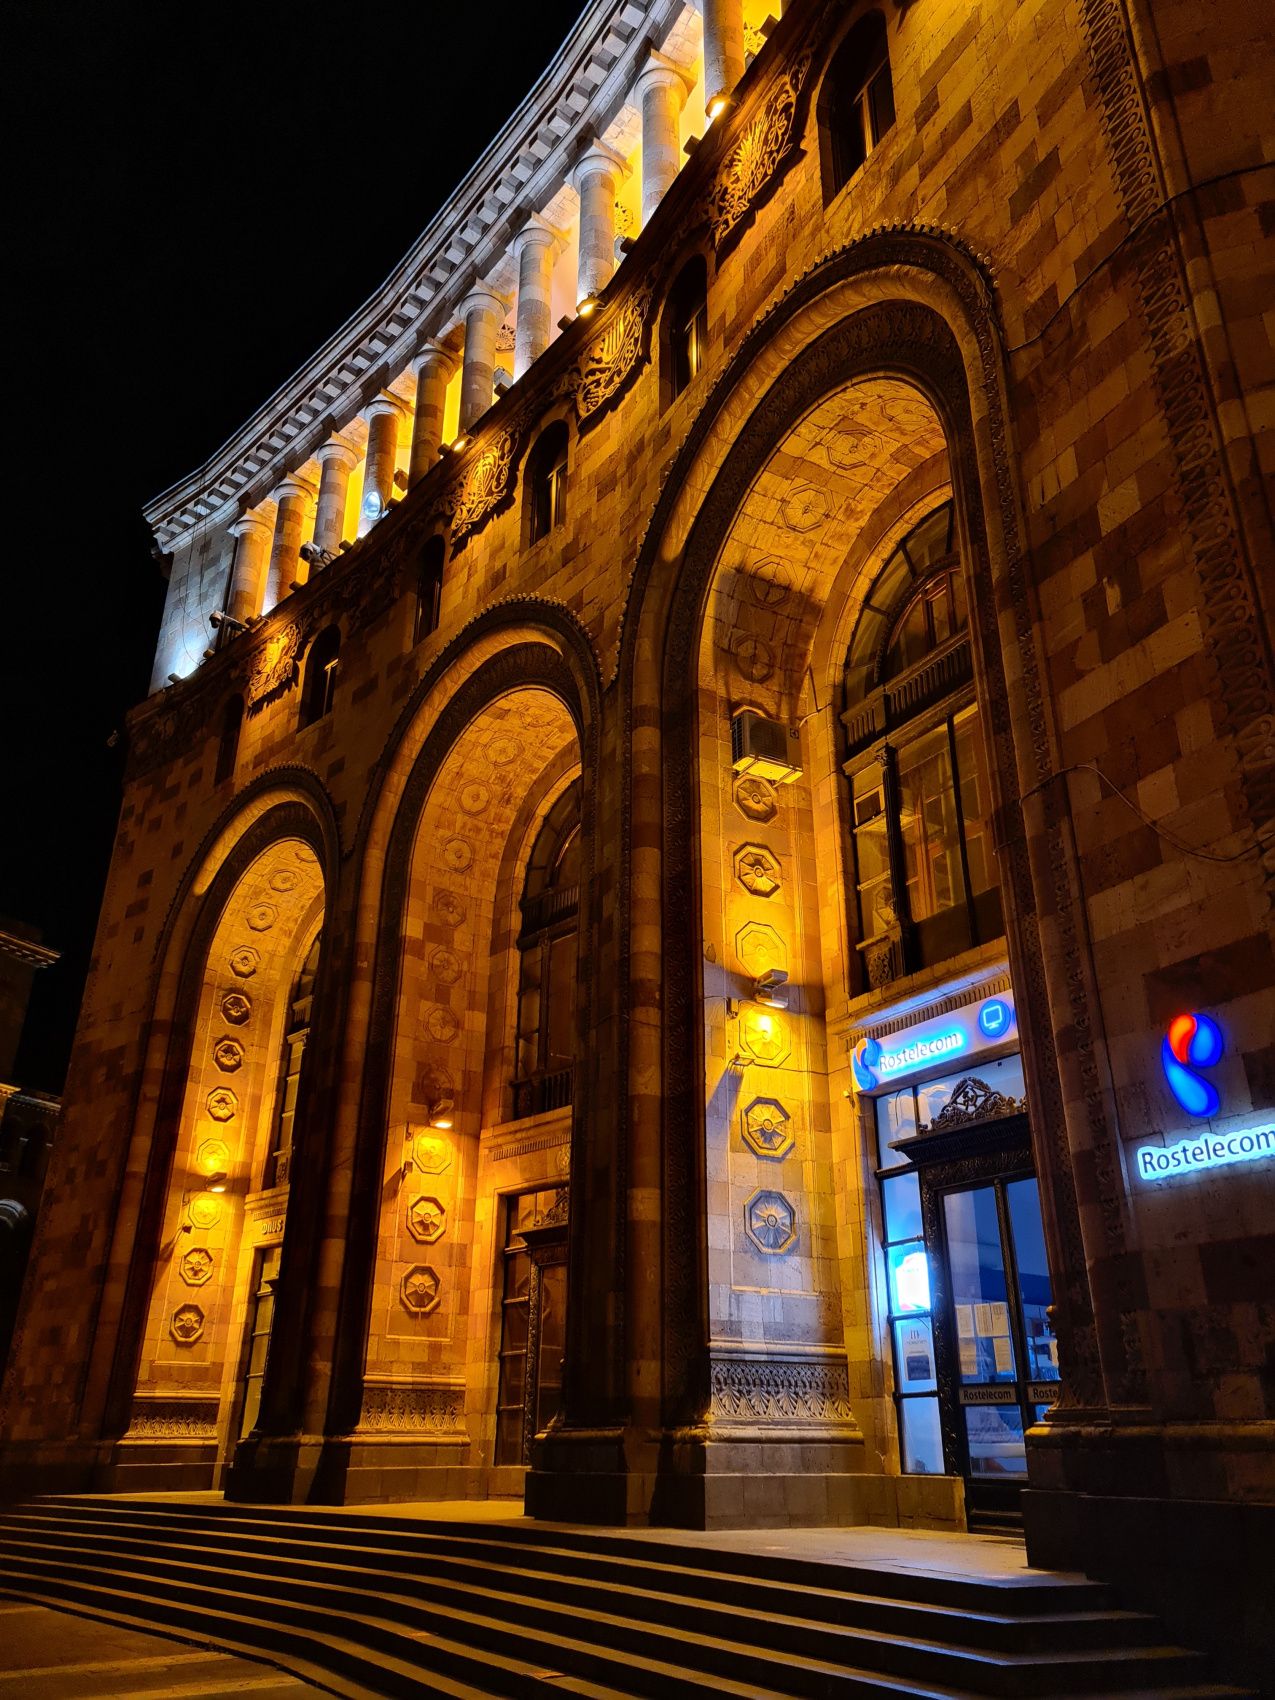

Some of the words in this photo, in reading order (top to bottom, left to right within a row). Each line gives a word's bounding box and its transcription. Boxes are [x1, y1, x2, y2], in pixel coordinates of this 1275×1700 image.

[879, 1033, 959, 1071] Rostelecom
[1141, 1130, 1275, 1173] Rostelecom
[963, 1389, 1011, 1400] Rostelecom
[1033, 1387, 1058, 1399] Roste
